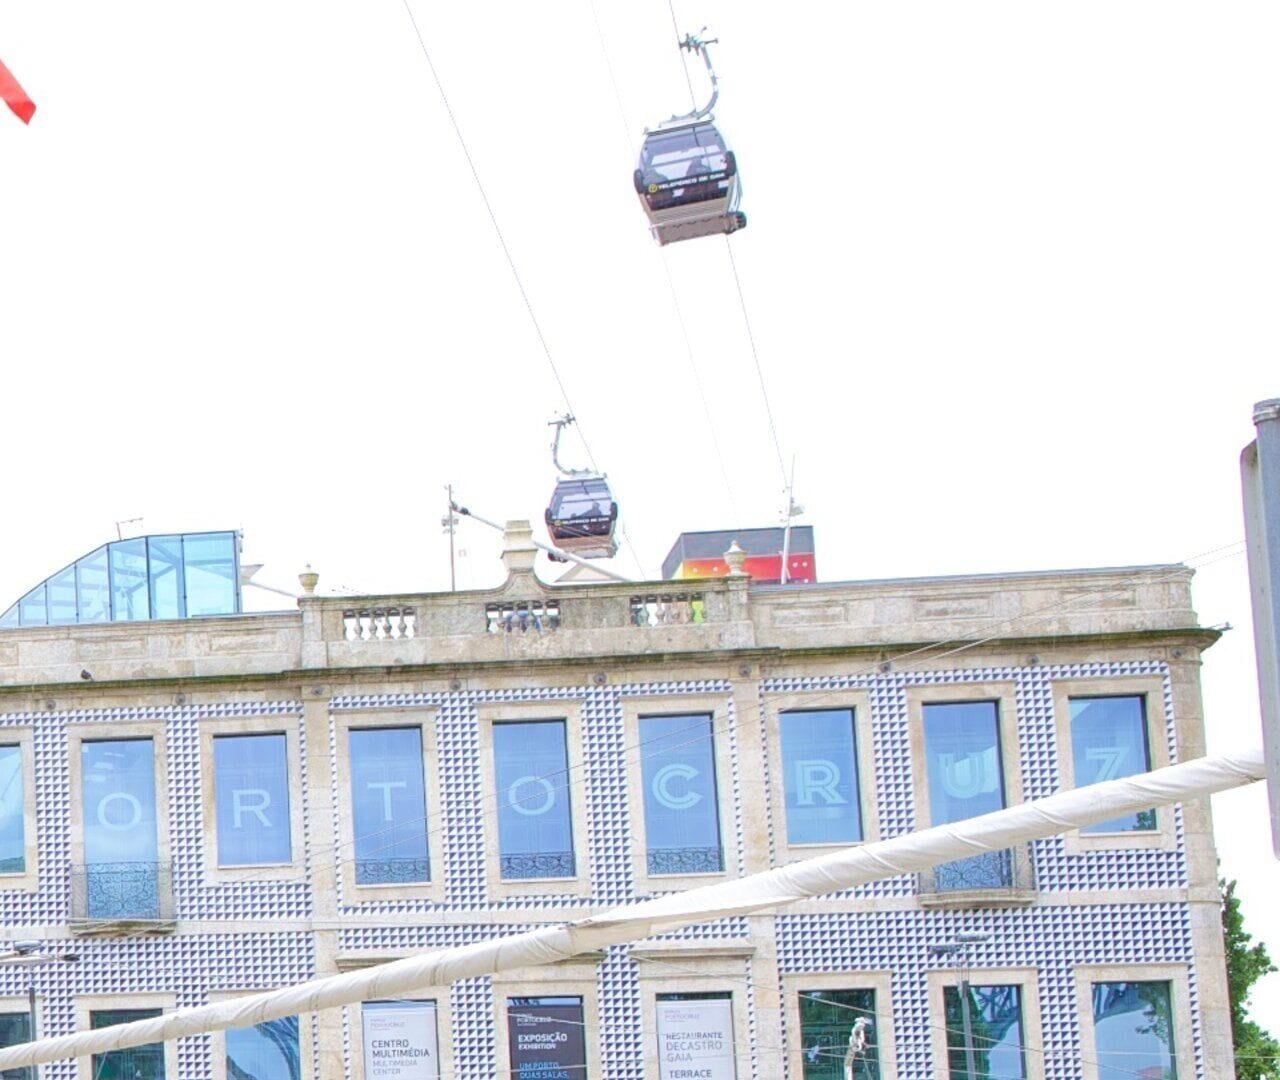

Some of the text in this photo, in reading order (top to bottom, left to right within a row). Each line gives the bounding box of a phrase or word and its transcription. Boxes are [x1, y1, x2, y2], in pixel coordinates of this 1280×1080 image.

[518, 1031, 568, 1043] EXPOSIÇÃO
[666, 1031, 723, 1040] RESTAURANTE
[371, 1039, 410, 1048] CENTRO
[518, 1042, 557, 1051] EXHIBITION
[666, 1041, 723, 1051] DECASTRO
[372, 1047, 430, 1058] MULTIMÉDIA
[667, 1052, 693, 1063] GAIA
[669, 1069, 712, 1079] TERRACE
